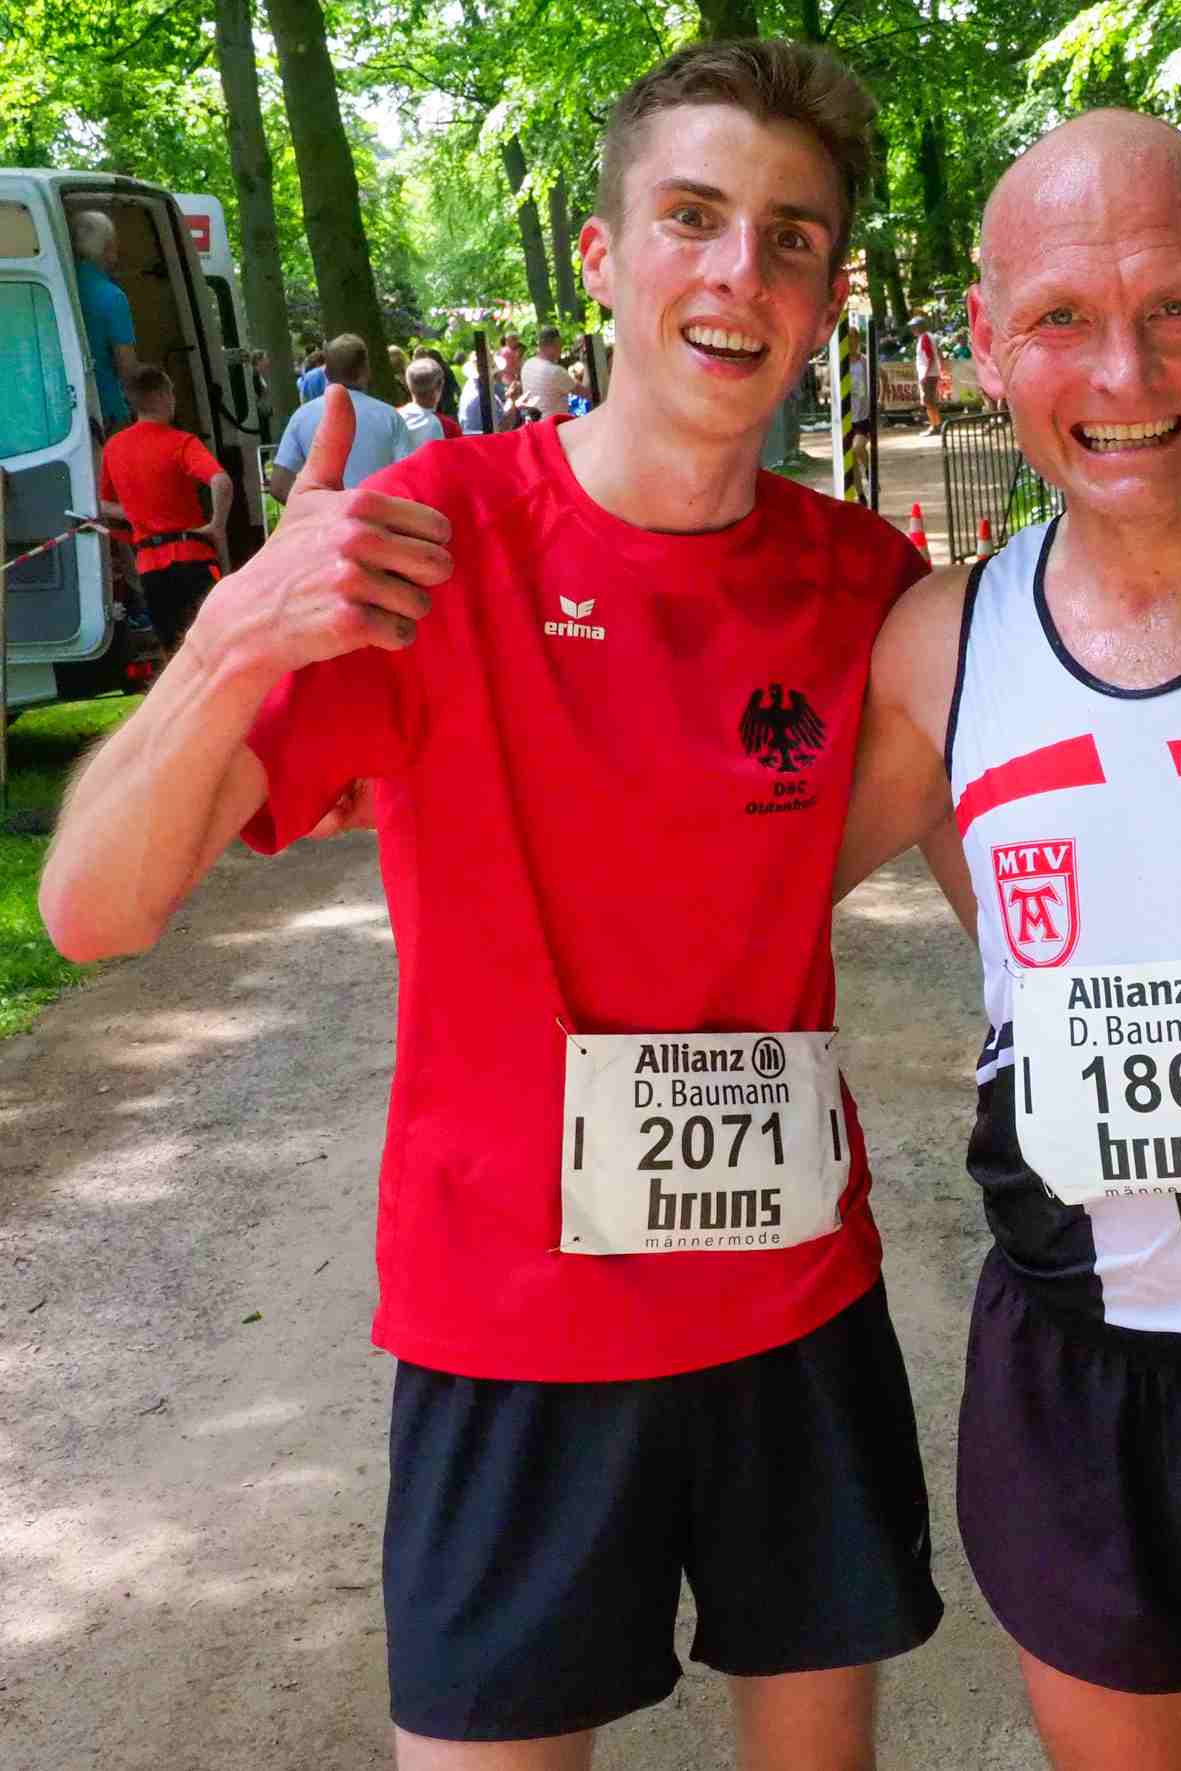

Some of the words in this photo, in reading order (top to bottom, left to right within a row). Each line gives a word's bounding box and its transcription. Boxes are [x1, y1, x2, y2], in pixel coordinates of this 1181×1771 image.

[544, 620, 606, 640] erima
[998, 845, 1070, 877] MTV
[1069, 1016, 1098, 1047] D.
[634, 1043, 745, 1074] Allianz
[634, 1080, 662, 1108] D.
[671, 1079, 790, 1107] Baumann
[637, 1112, 785, 1171] 2071
[648, 1178, 781, 1230] bruns
